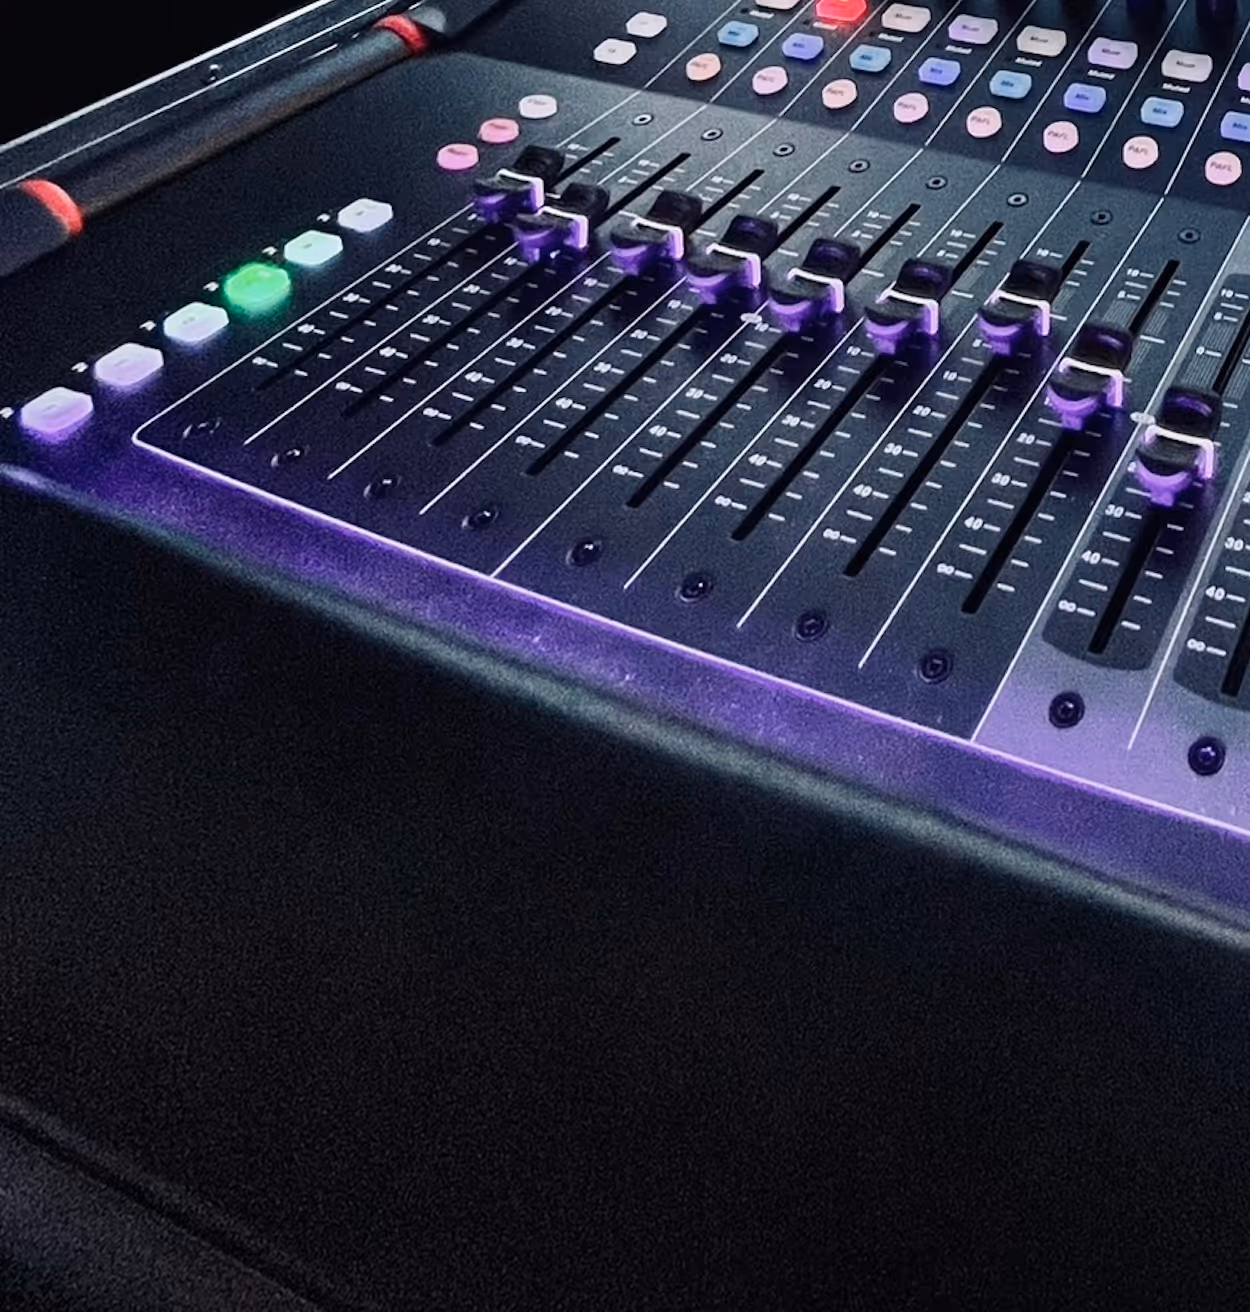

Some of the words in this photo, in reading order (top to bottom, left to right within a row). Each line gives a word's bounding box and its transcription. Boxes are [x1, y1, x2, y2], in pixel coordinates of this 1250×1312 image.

[1220, 288, 1234, 298] 10
[1196, 346, 1205, 355] 0
[943, 371, 958, 381] 10
[813, 378, 832, 390] 20
[685, 387, 704, 399] 30
[912, 404, 932, 417] 20
[781, 414, 800, 427] 30
[649, 424, 667, 437] 40
[1017, 432, 1036, 445] 20
[883, 442, 903, 456] 30
[748, 453, 768, 466] 40
[991, 472, 1011, 486] 30
[853, 483, 873, 498] 40
[1104, 504, 1124, 518] 30
[964, 516, 984, 530] 40
[1224, 536, 1244, 551] 30
[1081, 550, 1101, 564] 40
[1205, 585, 1226, 601] 40
